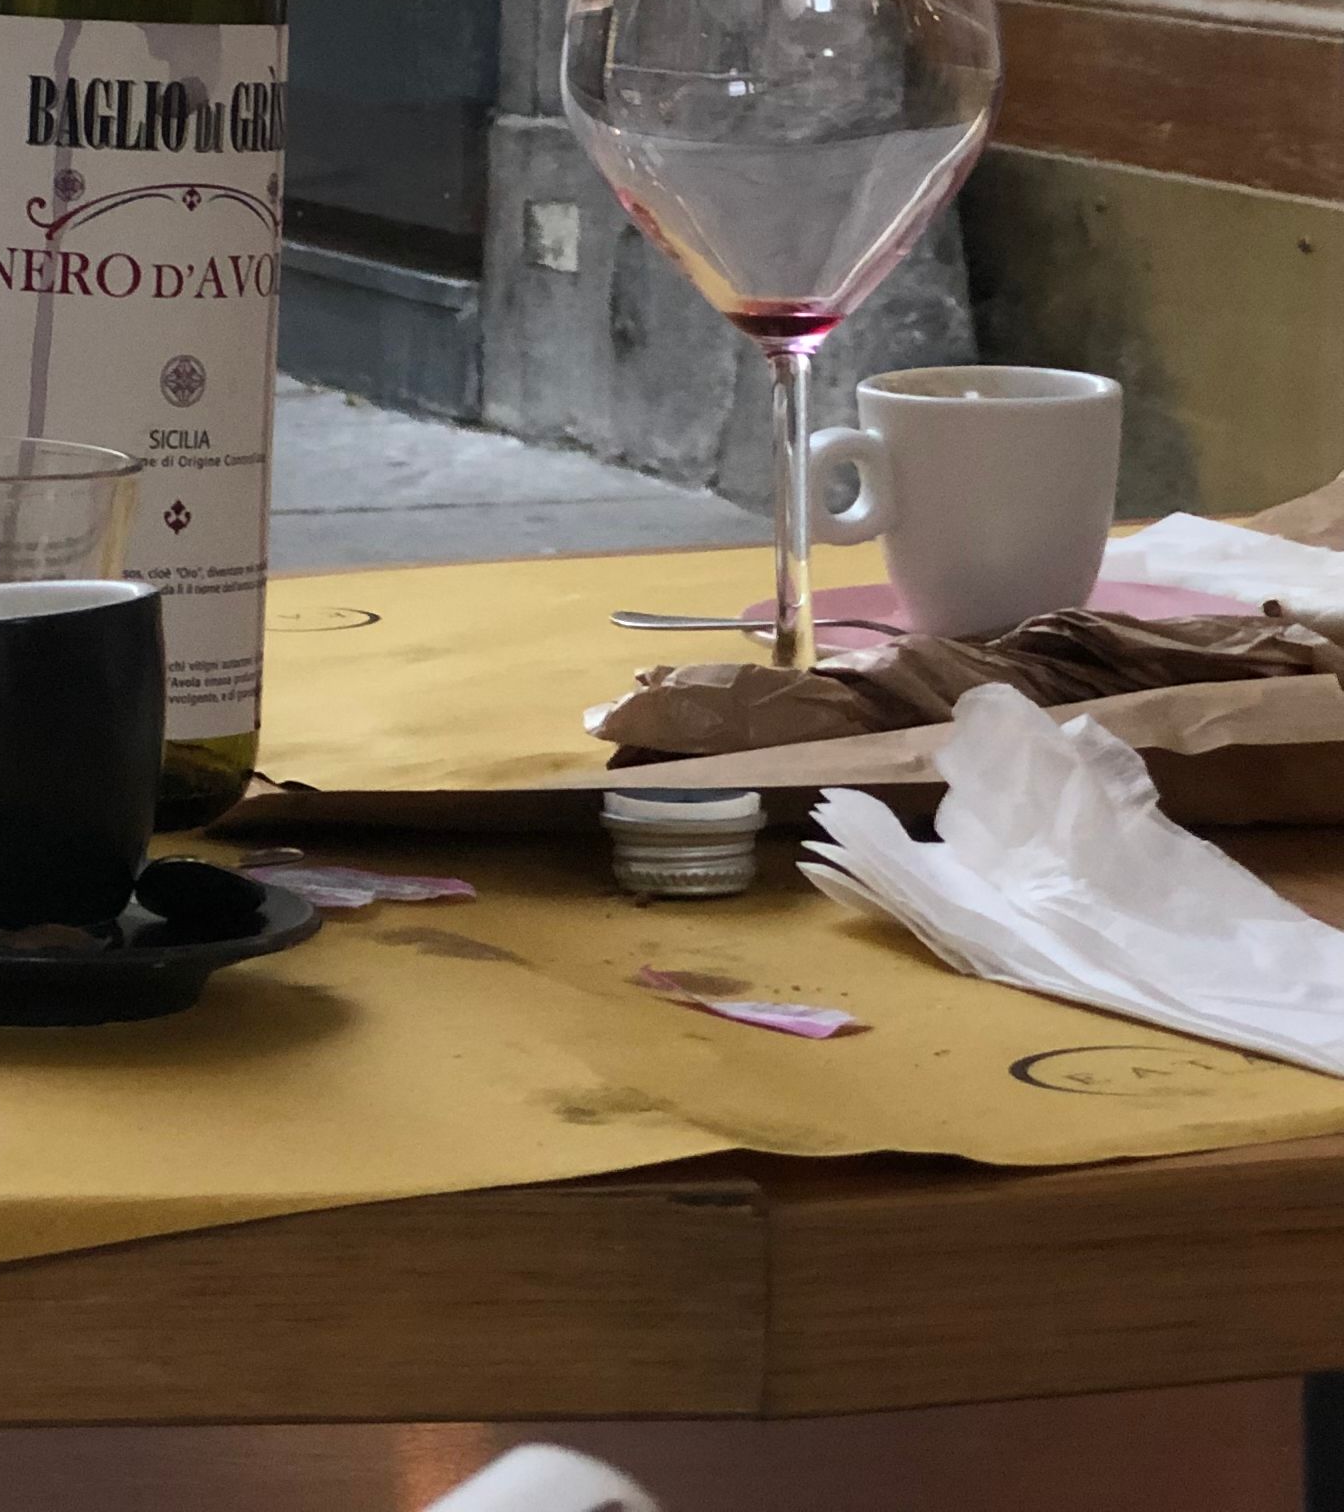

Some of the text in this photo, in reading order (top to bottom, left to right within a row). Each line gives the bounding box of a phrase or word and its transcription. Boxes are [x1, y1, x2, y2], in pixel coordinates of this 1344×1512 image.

[25, 74, 189, 152] BAGLIO
[149, 429, 211, 450] SICILIA
[178, 455, 221, 470] Origine
